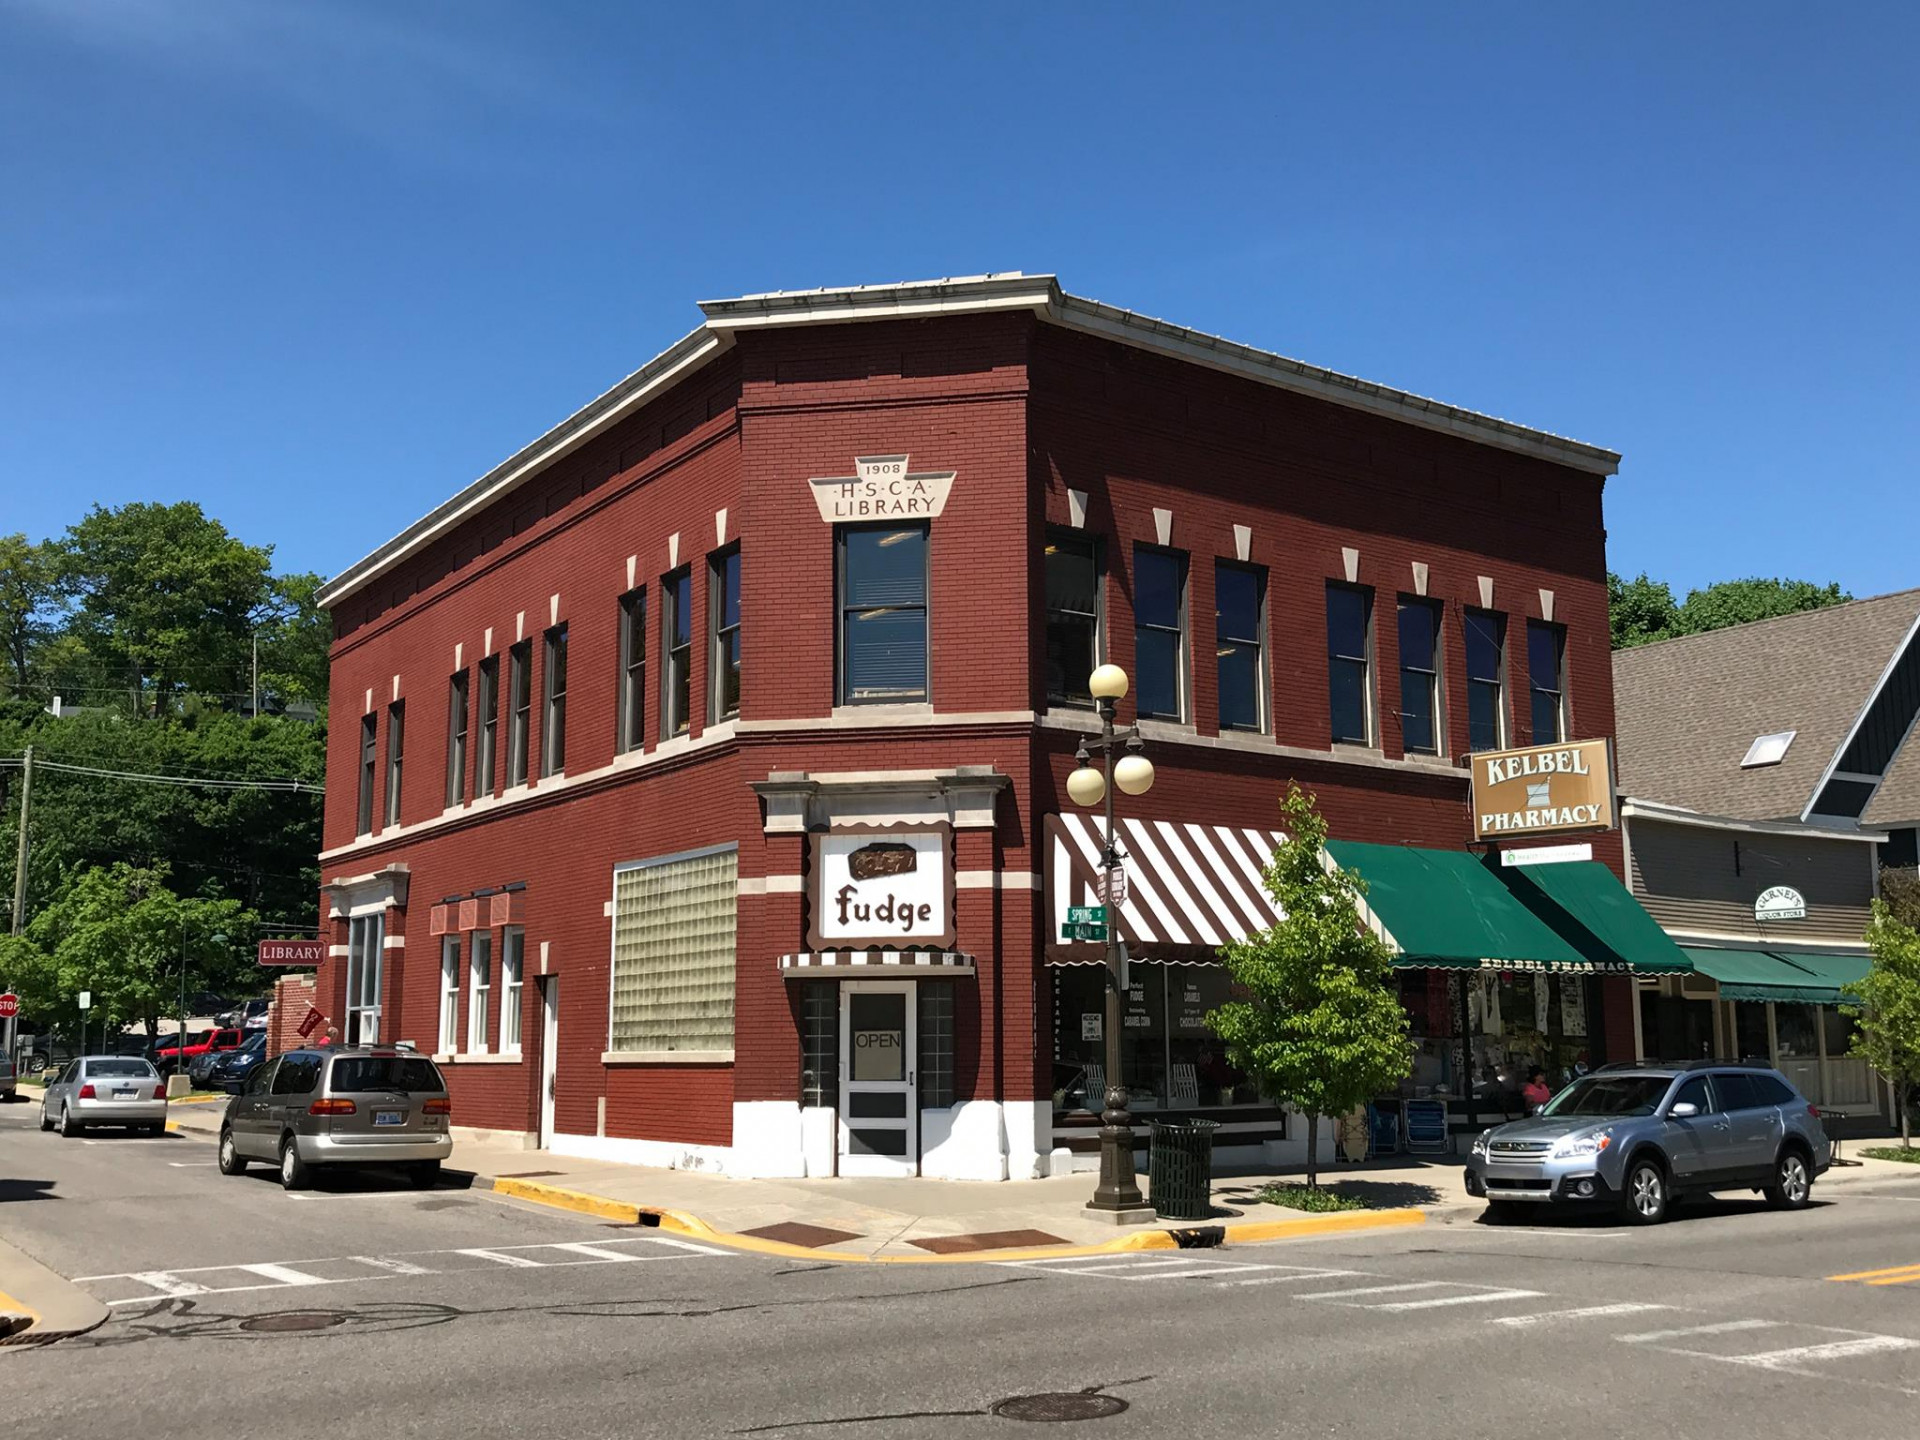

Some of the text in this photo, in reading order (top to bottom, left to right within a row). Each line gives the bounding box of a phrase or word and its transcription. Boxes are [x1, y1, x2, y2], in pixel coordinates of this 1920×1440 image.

[866, 464, 900, 475] 1908
[835, 497, 935, 517] LIBRARY
[1486, 749, 1590, 786] KELBEL
[1481, 804, 1602, 832] PHARMACY
[835, 884, 932, 932] fudge
[1071, 908, 1092, 920] SPRING
[1075, 925, 1092, 938] MAIN
[262, 947, 322, 959] LIBRARY
[1480, 958, 1635, 971] KELBEL PHARMACY
[856, 1033, 900, 1048] OPEN
